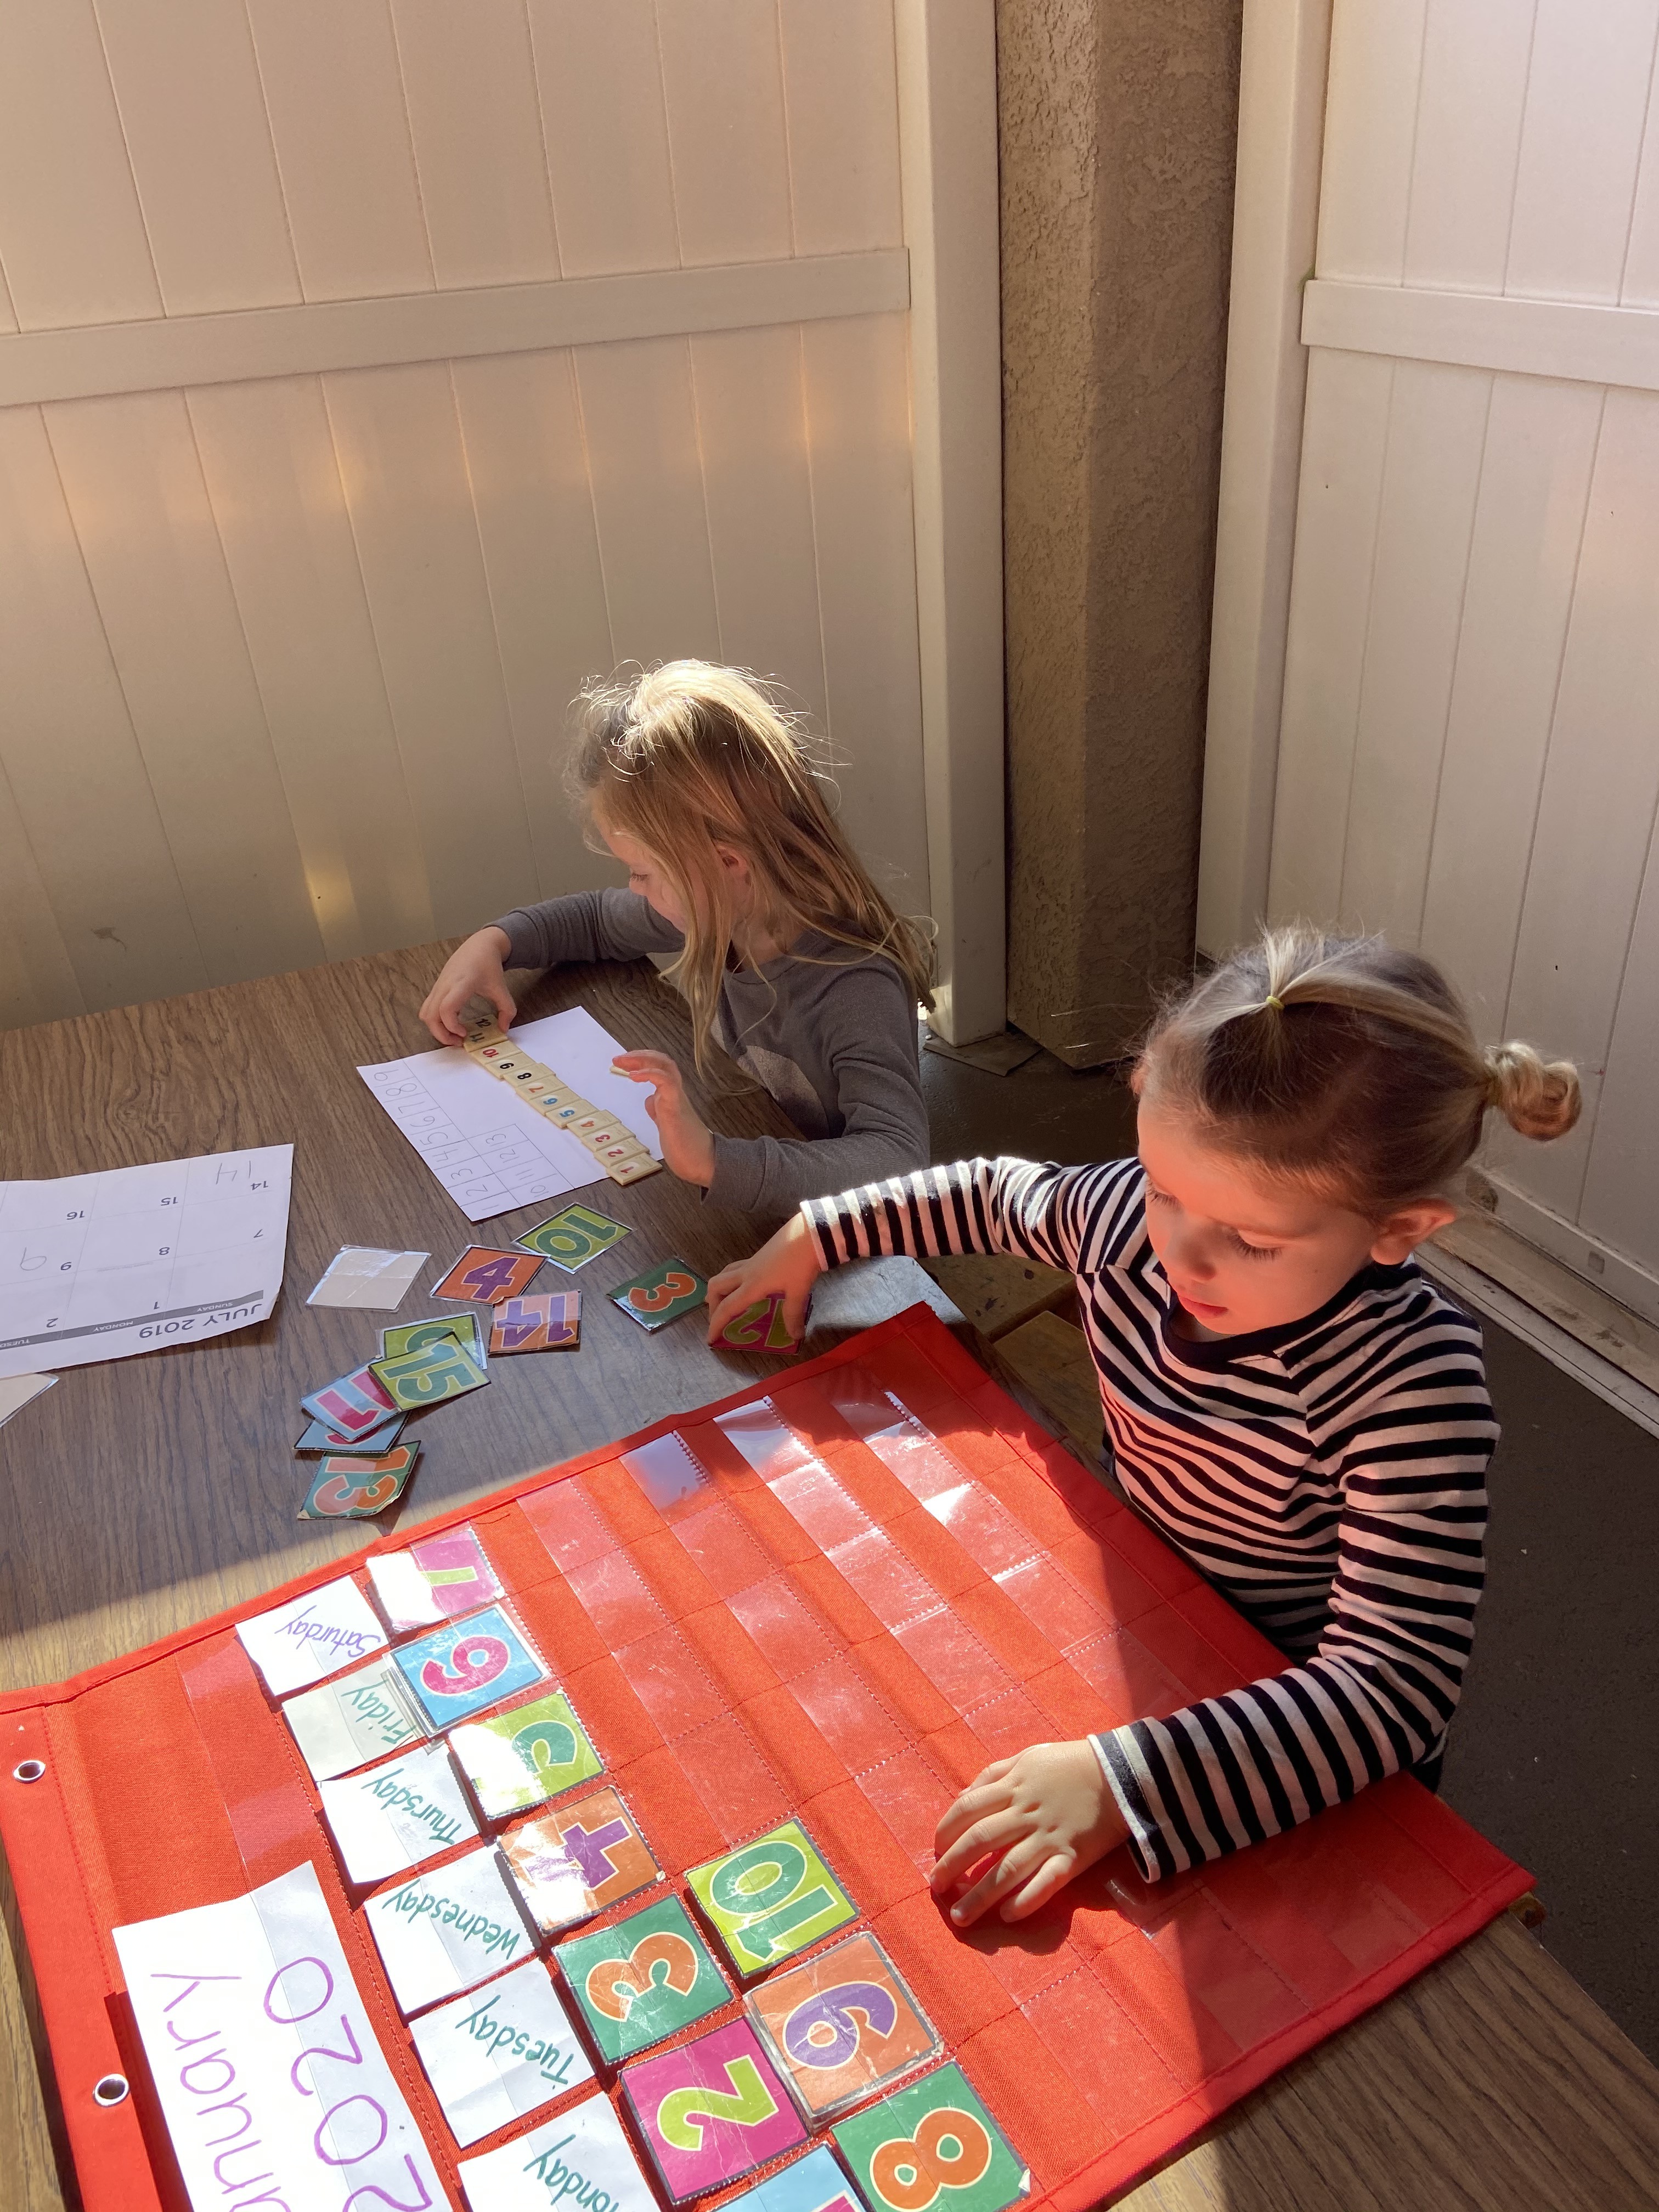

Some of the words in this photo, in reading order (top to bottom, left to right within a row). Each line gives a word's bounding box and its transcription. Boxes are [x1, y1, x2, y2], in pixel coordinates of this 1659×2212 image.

[476, 1018, 491, 1028] 12
[482, 1048, 499, 1058] 10
[374, 1069, 399, 1081] 9
[386, 1083, 417, 1096] 8
[398, 1101, 425, 1114] 7
[410, 1116, 435, 1127] 6
[420, 1132, 448, 1146] 5
[486, 1133, 506, 1147] 13
[595, 1134, 610, 1142] 3
[432, 1149, 459, 1162] 4
[500, 1149, 520, 1163] 12
[608, 1149, 624, 1157] 2
[216, 1160, 251, 1184] 14
[450, 1168, 472, 1180] 3
[515, 1169, 534, 1181] 11
[251, 1181, 268, 1190] 14
[466, 1184, 488, 1197] 2
[530, 1185, 549, 1198] 10
[160, 1197, 179, 1206] 15
[66, 1210, 86, 1220] 16
[253, 1229, 263, 1238] 7
[535, 1213, 618, 1259] 10
[159, 1247, 170, 1255] 8
[20, 1247, 47, 1271] 9
[60, 1262, 72, 1271] 9
[461, 1256, 521, 1301] 4
[628, 1272, 697, 1312] 3
[154, 1301, 160, 1310] 1
[196, 1302, 233, 1312] SUNDAY
[202, 1304, 262, 1326] JULY
[495, 1294, 575, 1348] 14
[46, 1318, 59, 1328] 2
[93, 1321, 133, 1332] MONDAY
[139, 1319, 195, 1338] 2019
[380, 1343, 479, 1402] 15
[313, 1445, 411, 1515] 13
[275, 1605, 381, 1657] Saturday
[420, 1635, 511, 1696] 6
[341, 1679, 416, 1745] Friday
[361, 1768, 461, 1846] Thursday
[525, 1817, 634, 1890] 4
[709, 1841, 838, 1963] 10
[381, 1878, 521, 1960] Wednesday
[585, 1931, 699, 2022] 3
[455, 1995, 574, 2085] Tuesday
[263, 1956, 433, 2212] 2020
[657, 2053, 780, 2152] 2
[870, 2106, 992, 2212] 8
[523, 2134, 619, 2212] onday
